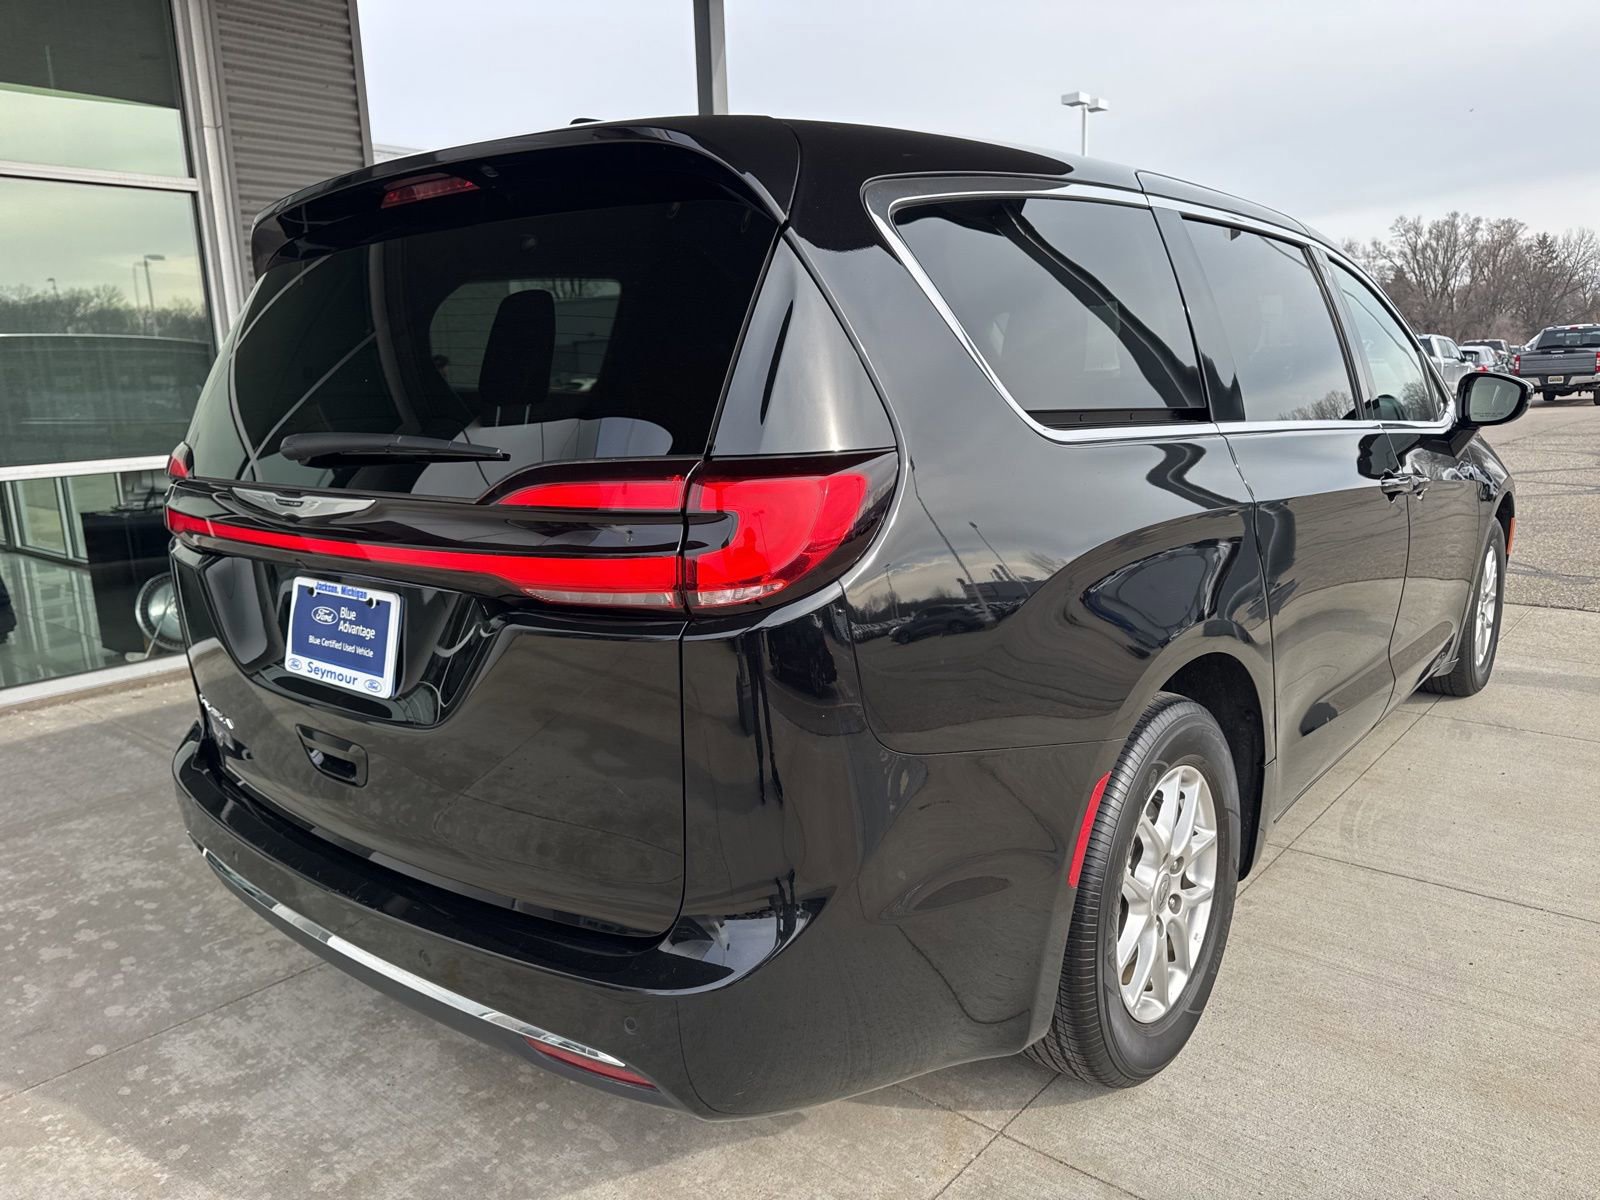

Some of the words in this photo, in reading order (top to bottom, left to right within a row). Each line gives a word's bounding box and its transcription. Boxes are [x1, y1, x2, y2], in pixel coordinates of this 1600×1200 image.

[341, 585, 368, 599] Michigan
[315, 608, 334, 622] Ford
[339, 606, 357, 620] Blue
[338, 621, 376, 640] Advantage
[308, 635, 321, 645] Blue
[321, 638, 342, 650] Certified
[342, 642, 355, 653] Used
[356, 645, 374, 658] Vehicle
[307, 662, 358, 685] Seymour
